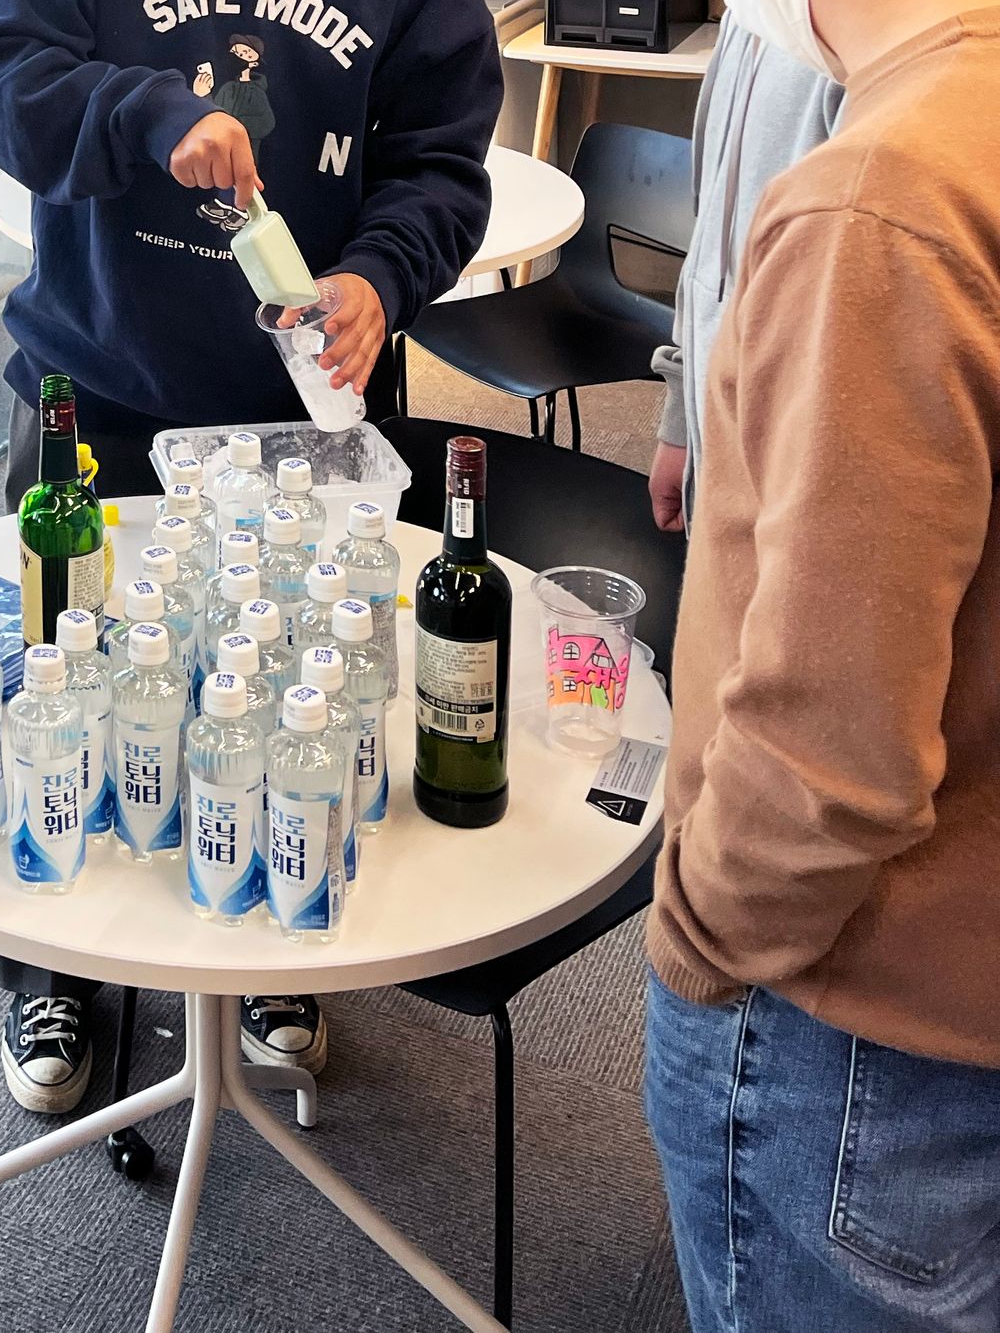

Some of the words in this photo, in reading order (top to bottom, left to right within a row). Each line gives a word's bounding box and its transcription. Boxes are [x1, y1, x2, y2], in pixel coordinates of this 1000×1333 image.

[189, 243, 233, 261] YOUR
[361, 717, 376, 736] 로
[123, 740, 162, 763] 진로
[360, 736, 375, 756] 닉
[125, 760, 162, 784] 토닉
[358, 756, 375, 776] 터
[42, 767, 77, 793] 진로
[125, 781, 161, 805] 워터
[43, 787, 77, 814] 토닉
[196, 794, 237, 821] 진로
[44, 807, 78, 835] 워터
[197, 815, 236, 843] 토닉
[270, 804, 307, 836] 진로
[198, 836, 236, 865] 워터
[272, 826, 306, 858] 토닉
[272, 848, 305, 881] 워터
